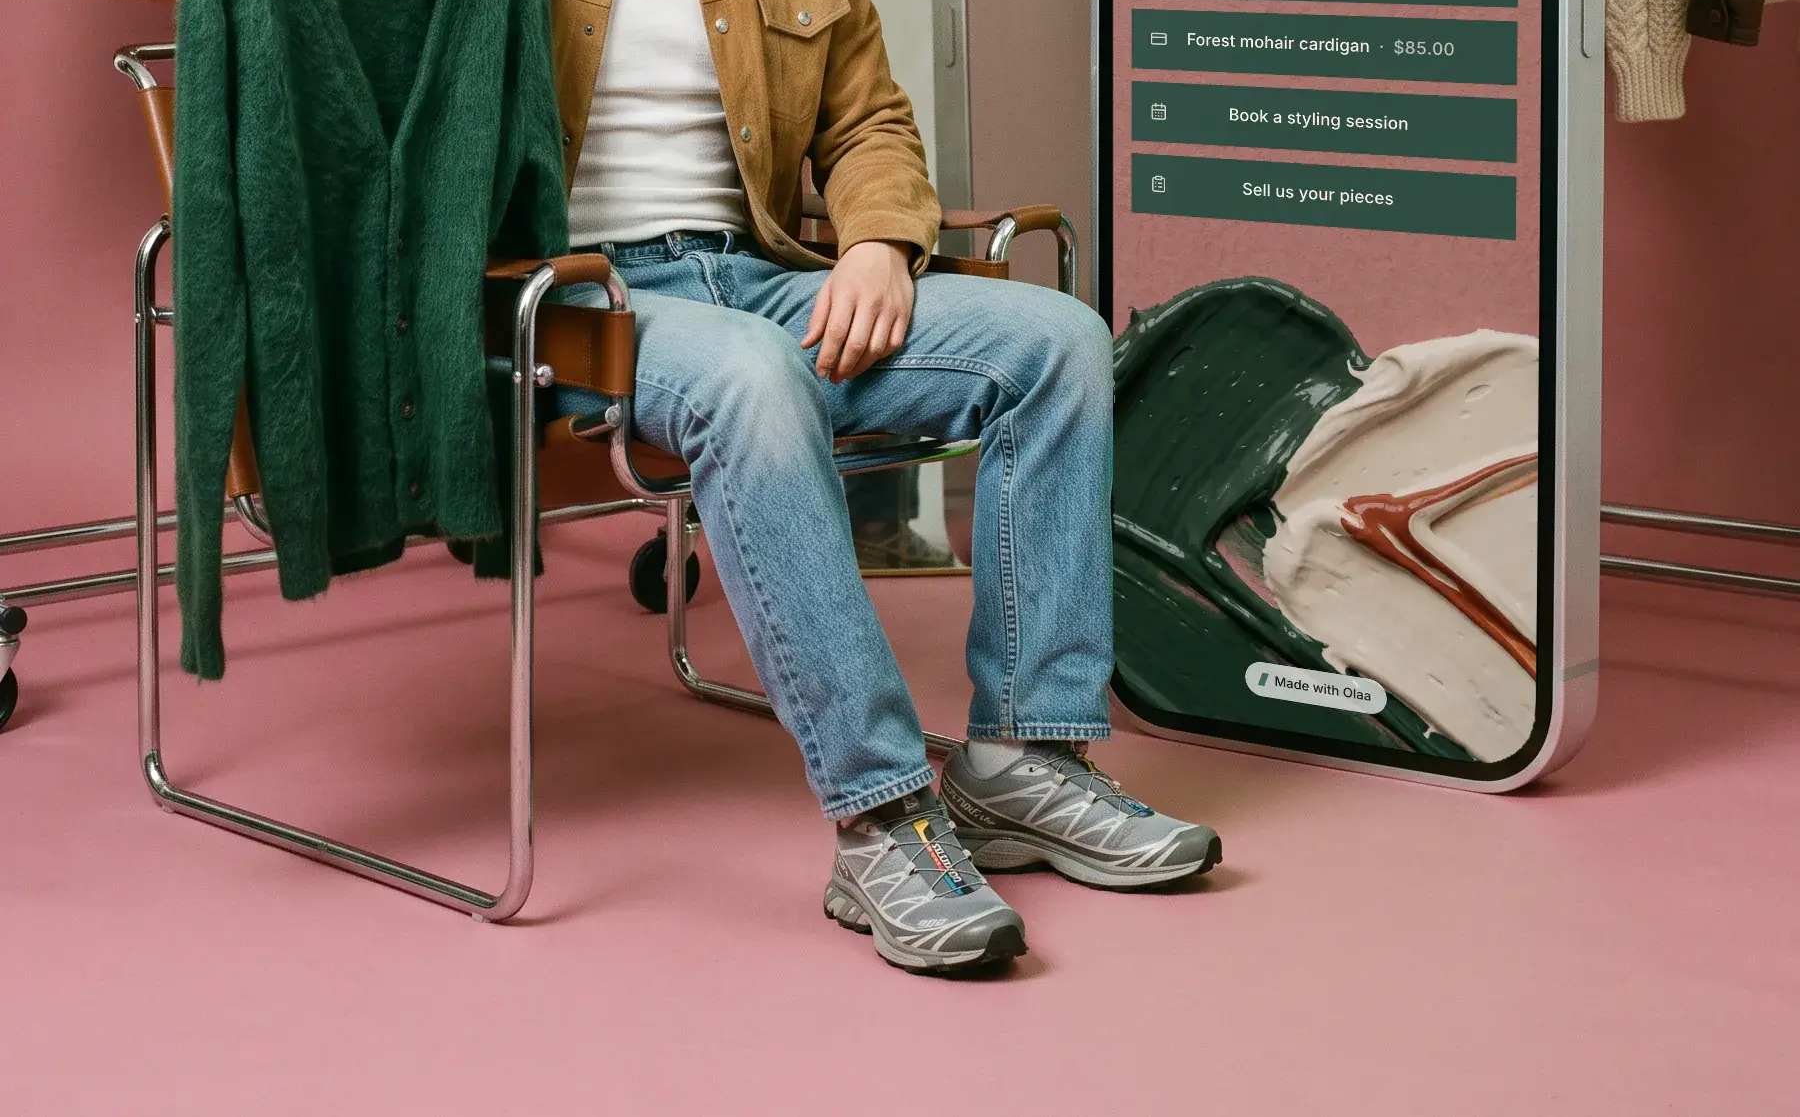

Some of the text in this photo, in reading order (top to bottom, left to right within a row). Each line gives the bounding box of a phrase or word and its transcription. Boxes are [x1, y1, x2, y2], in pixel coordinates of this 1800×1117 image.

[1187, 32, 1236, 48] Forest
[1240, 34, 1295, 51] mohair
[1299, 36, 1370, 56] cardigan
[1394, 39, 1455, 57] $85.00
[1229, 107, 1409, 132] Book a styling session
[1242, 182, 1394, 206] Sell us your pieces
[1274, 676, 1371, 702] Made with Olaa
